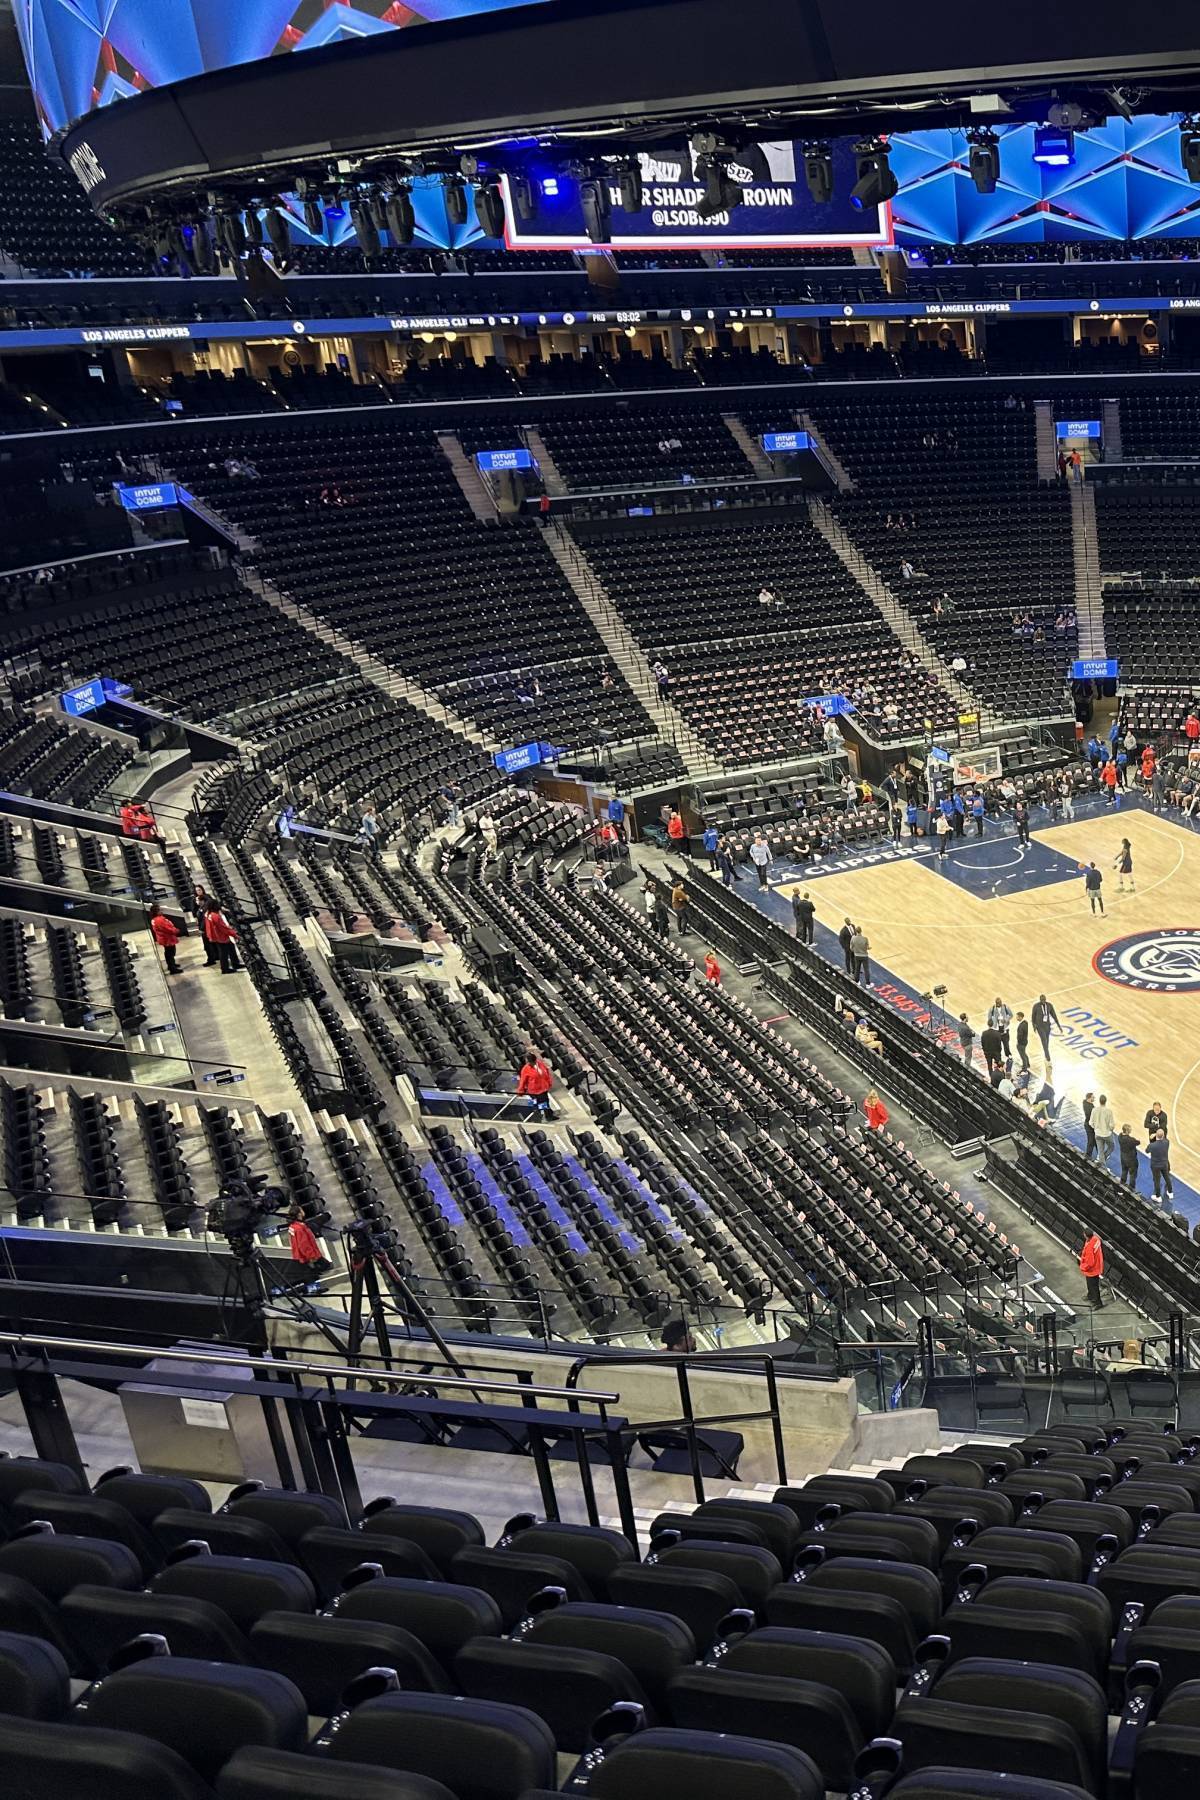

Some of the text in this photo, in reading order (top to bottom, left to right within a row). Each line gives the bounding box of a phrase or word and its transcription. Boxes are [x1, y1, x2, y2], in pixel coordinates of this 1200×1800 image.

[740, 188, 793, 206] ROWN
[926, 303, 1010, 313] LOS ANGELES CLIPPERS
[1170, 299, 1184, 308] LOS
[391, 319, 409, 329] LOS
[410, 318, 450, 328] ANGELES
[82, 327, 190, 342] LOS ANGELES CLIPPERS
[766, 844, 932, 885] LA CLIPPERS
[1101, 950, 1178, 991] CLIPPERS
